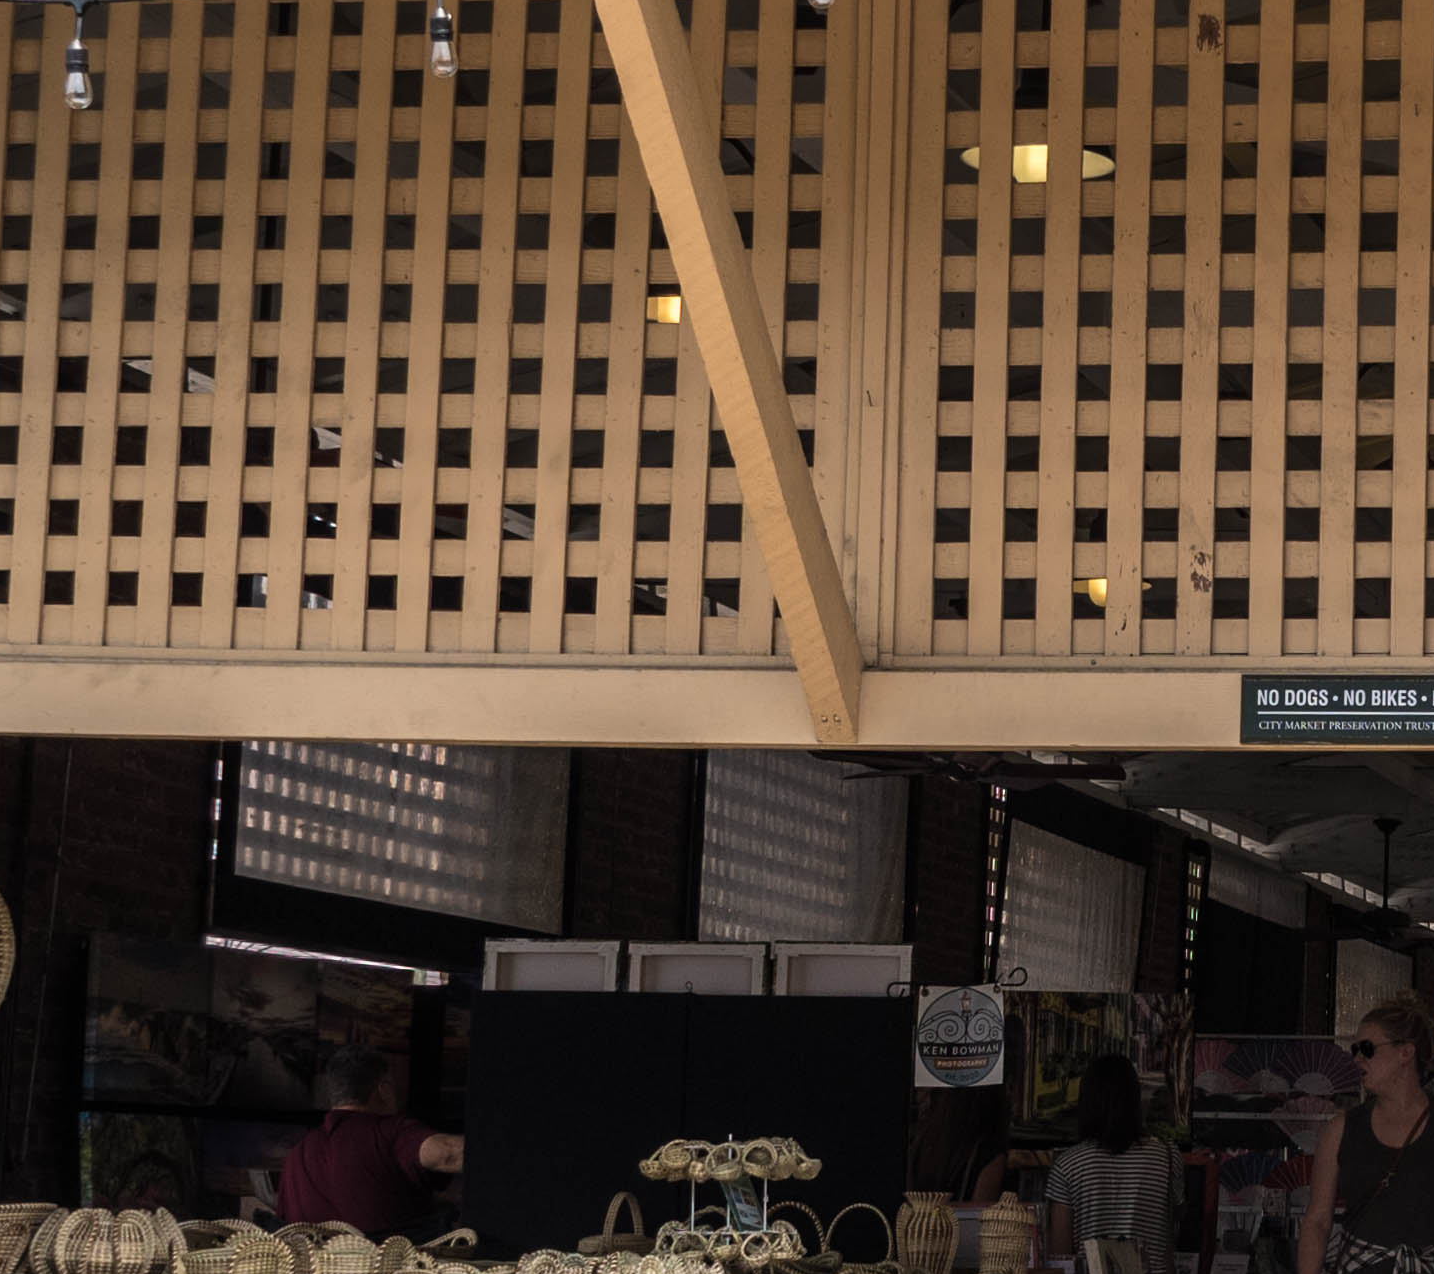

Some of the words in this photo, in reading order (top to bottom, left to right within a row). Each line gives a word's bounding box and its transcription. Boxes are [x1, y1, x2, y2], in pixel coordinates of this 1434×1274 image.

[1257, 689, 1280, 706] NO
[1285, 689, 1329, 706] DOGS
[1343, 689, 1366, 706] NO
[1371, 689, 1418, 707] BIKES
[1258, 720, 1283, 731] CITY
[1285, 721, 1326, 731] MARKET
[1329, 721, 1402, 731] PRESERVATION
[923, 1045, 948, 1056] KEN
[952, 1044, 999, 1055] BOWMAN
